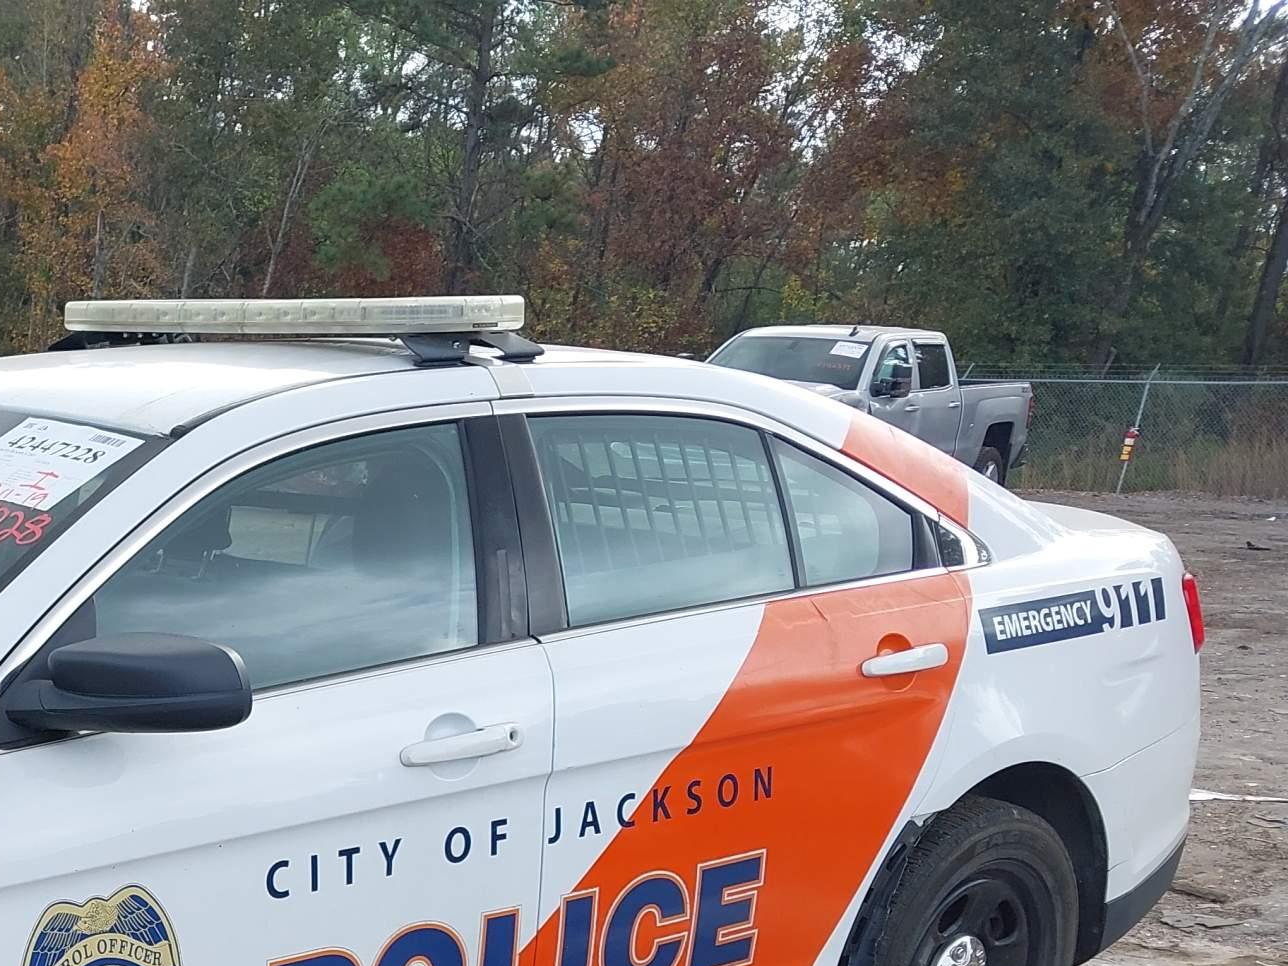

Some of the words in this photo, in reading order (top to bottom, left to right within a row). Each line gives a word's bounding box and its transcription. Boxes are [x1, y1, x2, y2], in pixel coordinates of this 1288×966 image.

[7, 435, 106, 463] 42447228
[992, 600, 1092, 641] EMERGENCY
[1094, 577, 1162, 633] 911
[265, 838, 402, 899] CITY
[444, 818, 509, 864] OF
[547, 766, 774, 845] JACKSON
[97, 938, 162, 966] OFFICER
